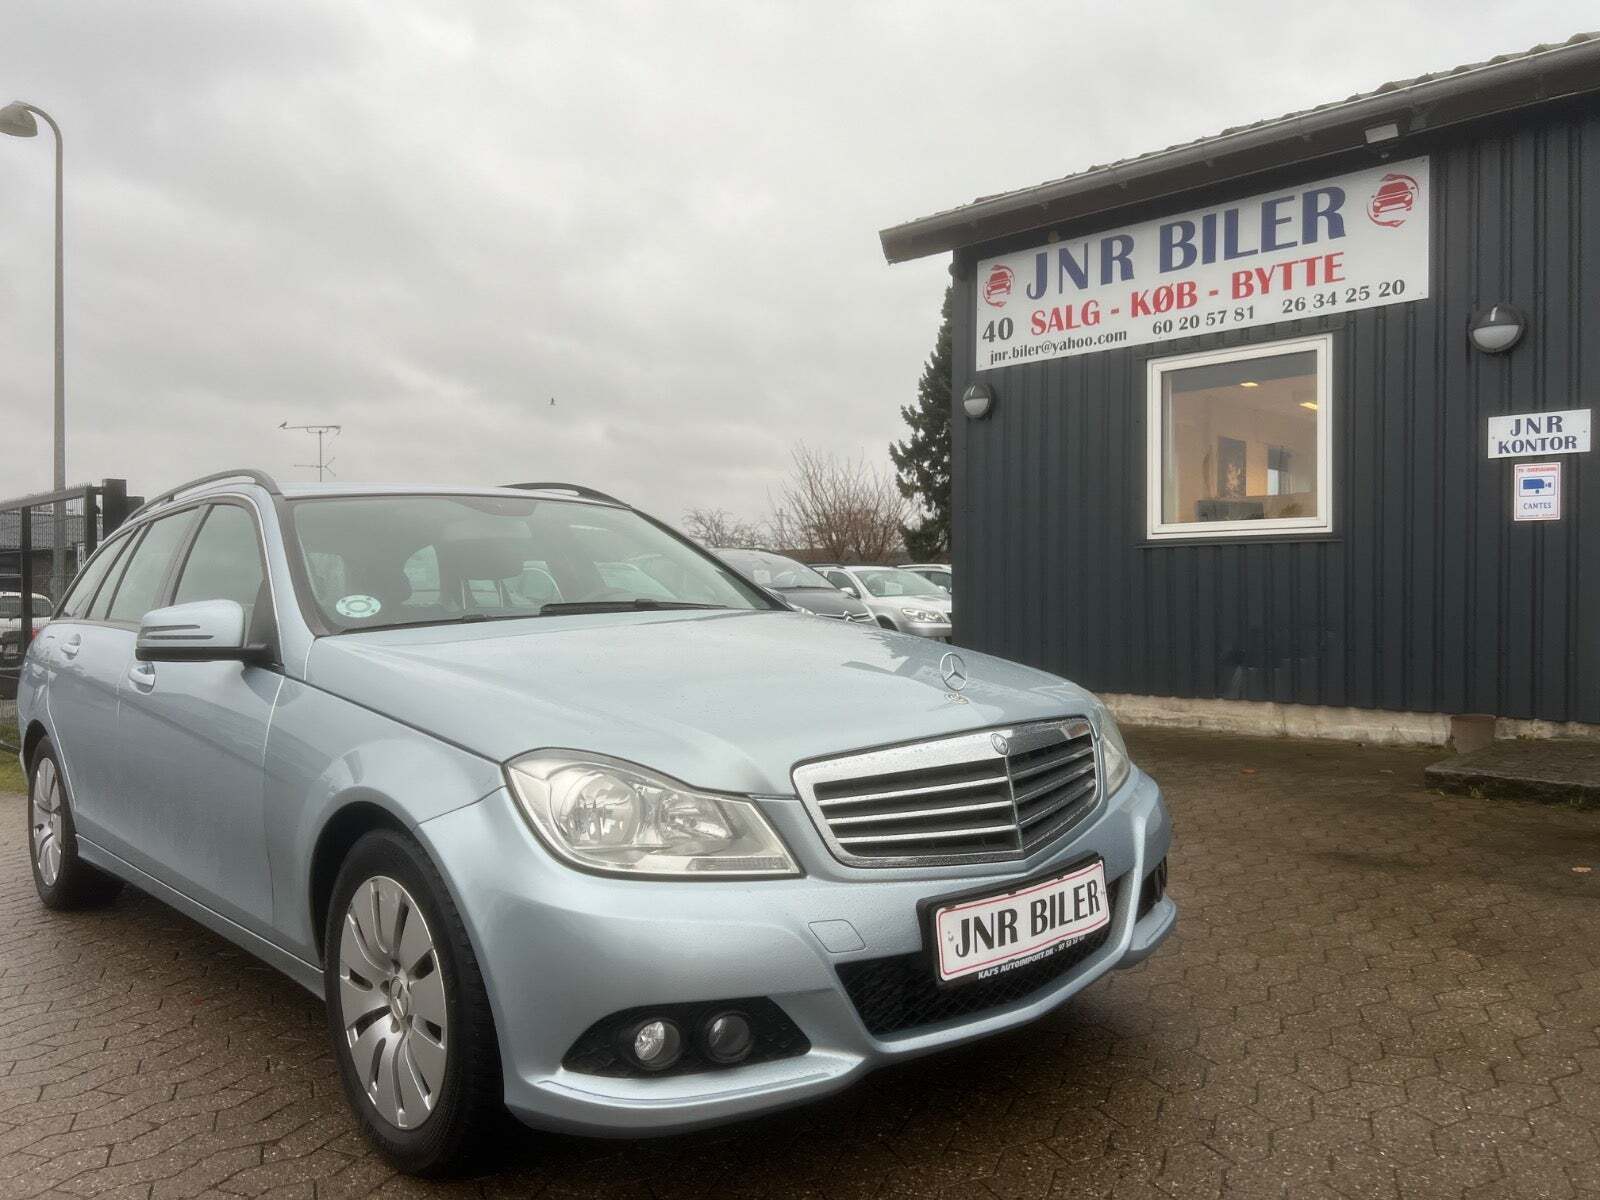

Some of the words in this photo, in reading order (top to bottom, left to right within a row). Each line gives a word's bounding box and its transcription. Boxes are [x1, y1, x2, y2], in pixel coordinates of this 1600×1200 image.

[1026, 234, 1134, 300] JNR
[1160, 186, 1346, 273] BILER
[1031, 300, 1101, 336] SALG
[1131, 281, 1198, 318] KØB
[1232, 252, 1346, 300] BYTTE
[1152, 319, 1173, 335] 60
[1179, 315, 1200, 331] 20
[1206, 310, 1227, 326] 57
[1233, 305, 1254, 321] 81
[1282, 298, 1306, 314] 26
[1313, 291, 1337, 309] 34
[1345, 285, 1370, 304] 25
[1379, 279, 1405, 298] 20
[982, 317, 1014, 343] 40
[990, 330, 1128, 365] jnr.biler@yahoo.com
[1498, 435, 1577, 455] KONTOR
[1510, 415, 1563, 437] JNR
[955, 908, 1019, 958] JNR
[1030, 879, 1101, 937] BILER
